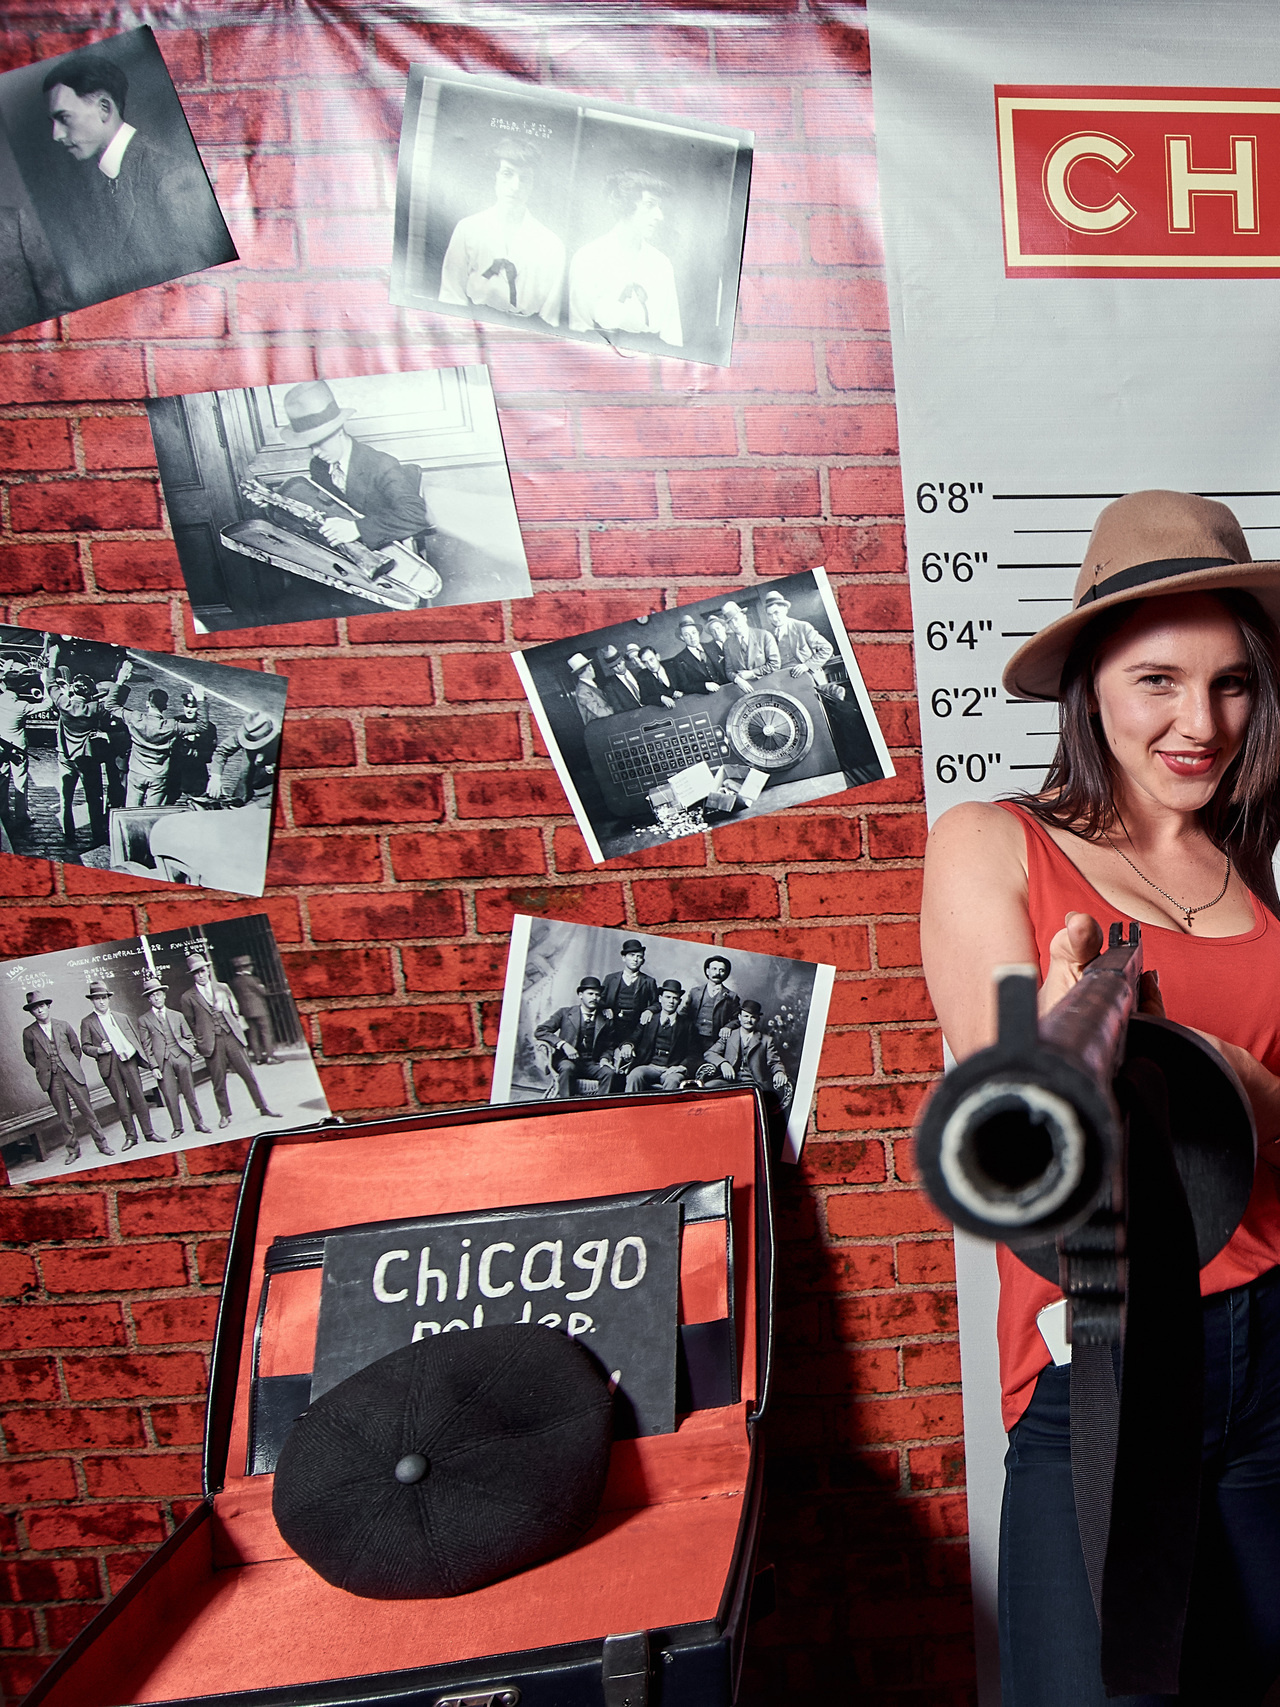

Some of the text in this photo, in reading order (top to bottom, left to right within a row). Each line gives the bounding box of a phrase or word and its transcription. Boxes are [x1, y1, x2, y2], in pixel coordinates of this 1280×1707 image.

[916, 482, 984, 513] 6'8"
[922, 552, 988, 583] 6'6"
[926, 620, 993, 650] 6'4"
[931, 687, 997, 718] 6'2"
[935, 752, 1001, 783] 6'0"
[372, 1236, 647, 1306] Chicago
